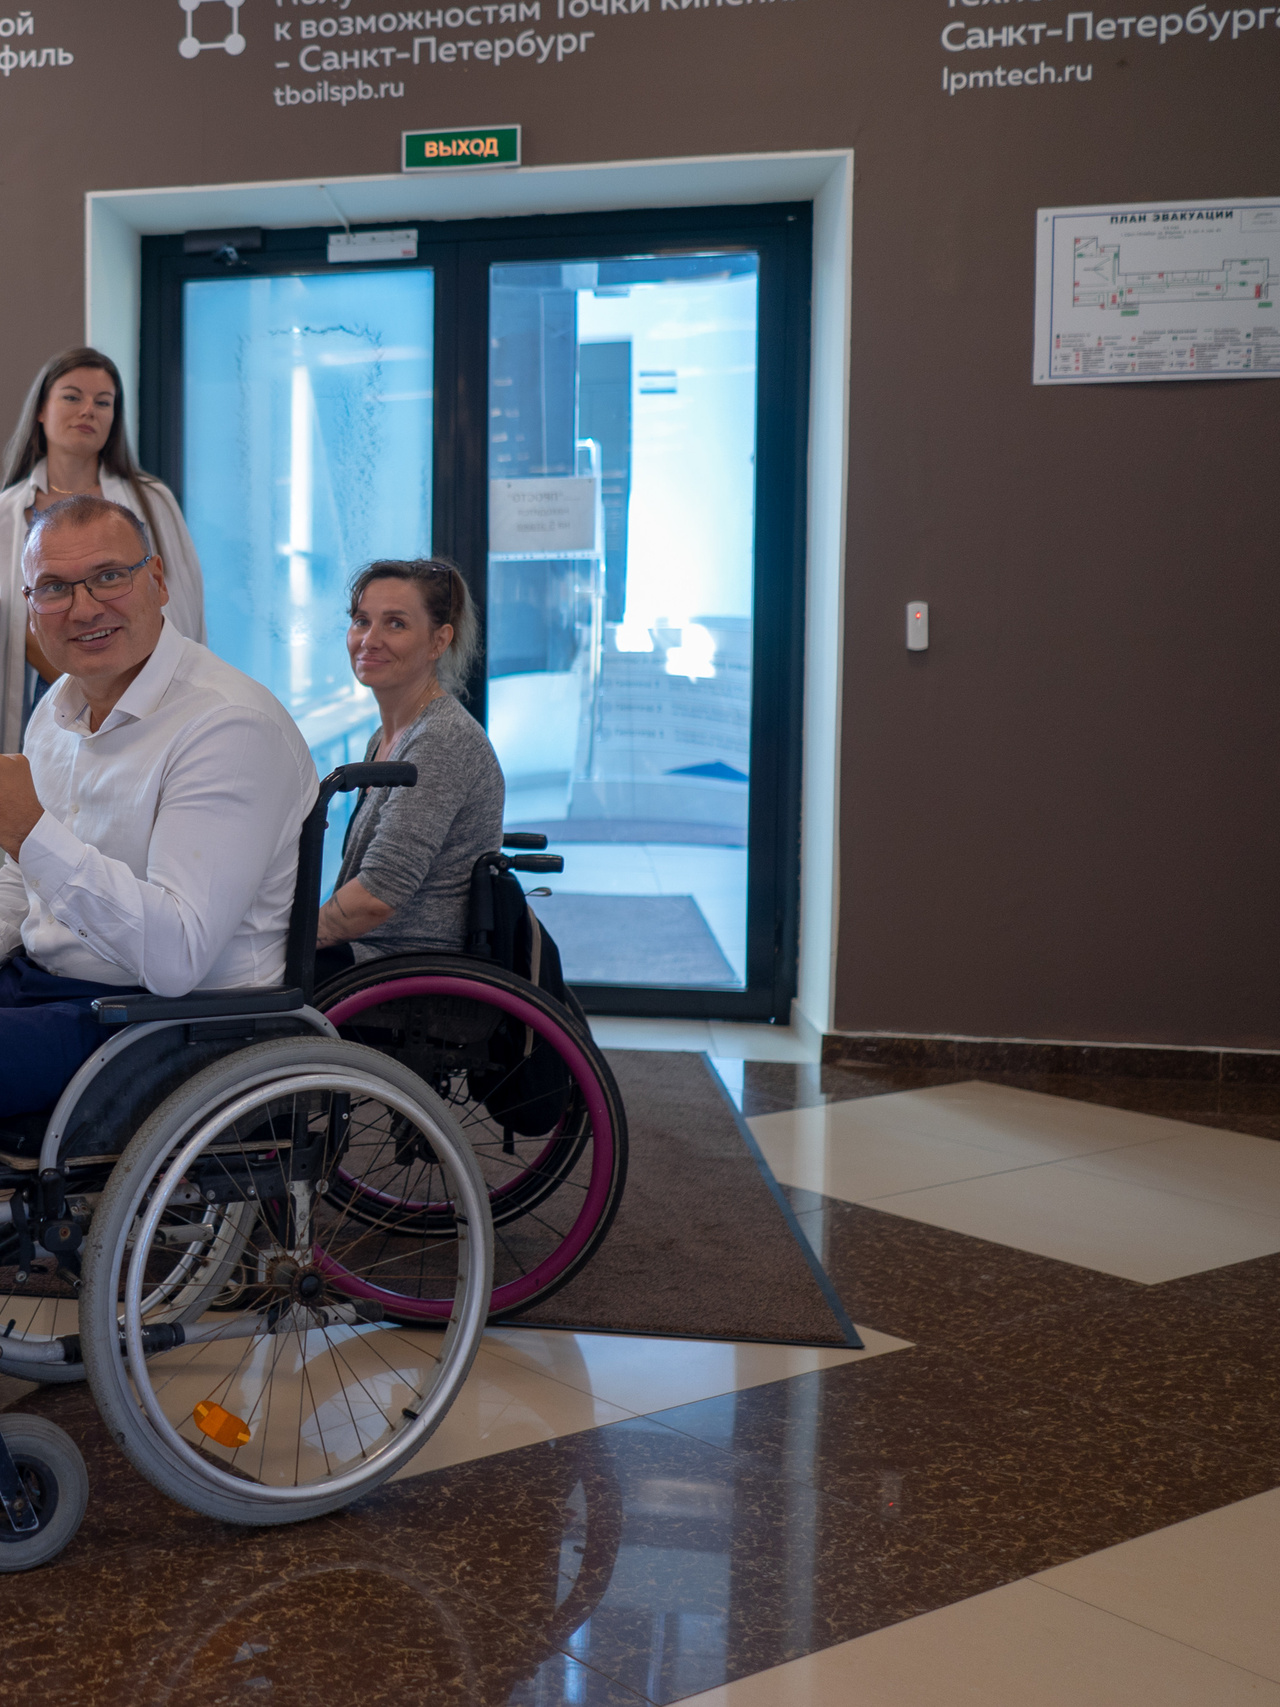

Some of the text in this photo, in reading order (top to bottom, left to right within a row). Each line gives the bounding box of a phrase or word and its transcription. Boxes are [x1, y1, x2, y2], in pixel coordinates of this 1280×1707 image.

[274, 22, 293, 41] к
[300, 1, 542, 40] возможностям
[941, 4, 1280, 52] Санкт-Петербург
[299, 29, 595, 73] Санкт-Петербург
[273, 79, 405, 107] tboilspb.ru
[942, 61, 1093, 96] lpmtech.ru
[424, 136, 499, 158] ВЫХОД
[1110, 210, 1234, 224] ПЛАН ЭВАКУАЦИИ
